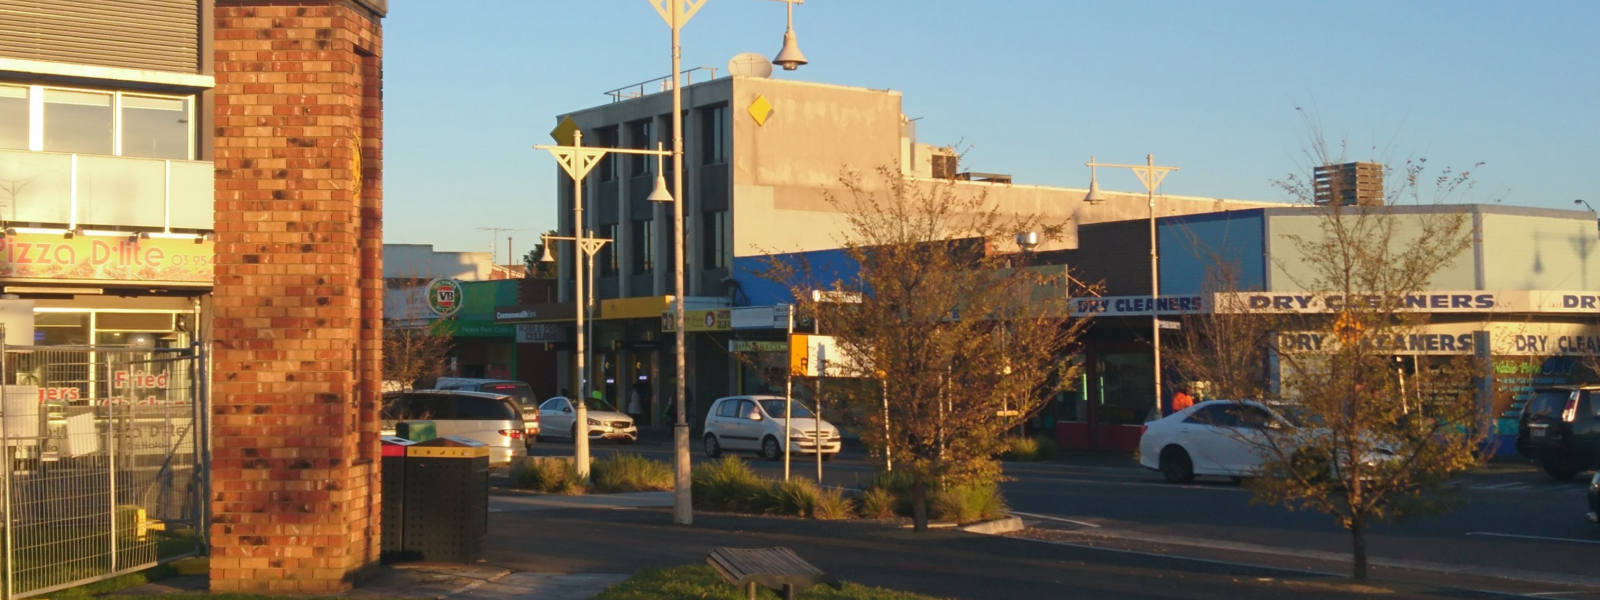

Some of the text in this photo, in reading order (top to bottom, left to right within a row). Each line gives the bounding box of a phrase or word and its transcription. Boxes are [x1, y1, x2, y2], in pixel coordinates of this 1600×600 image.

[439, 291, 454, 301] VB
[1249, 295, 1313, 309] DRY
[1563, 295, 1600, 308] DR
[1078, 296, 1202, 313] DRY CLEANERS
[1282, 333, 1473, 352] DRY EANERS
[1515, 334, 1600, 353] DRY CLEA
[115, 370, 169, 387] Fied
[38, 387, 79, 403] gers
